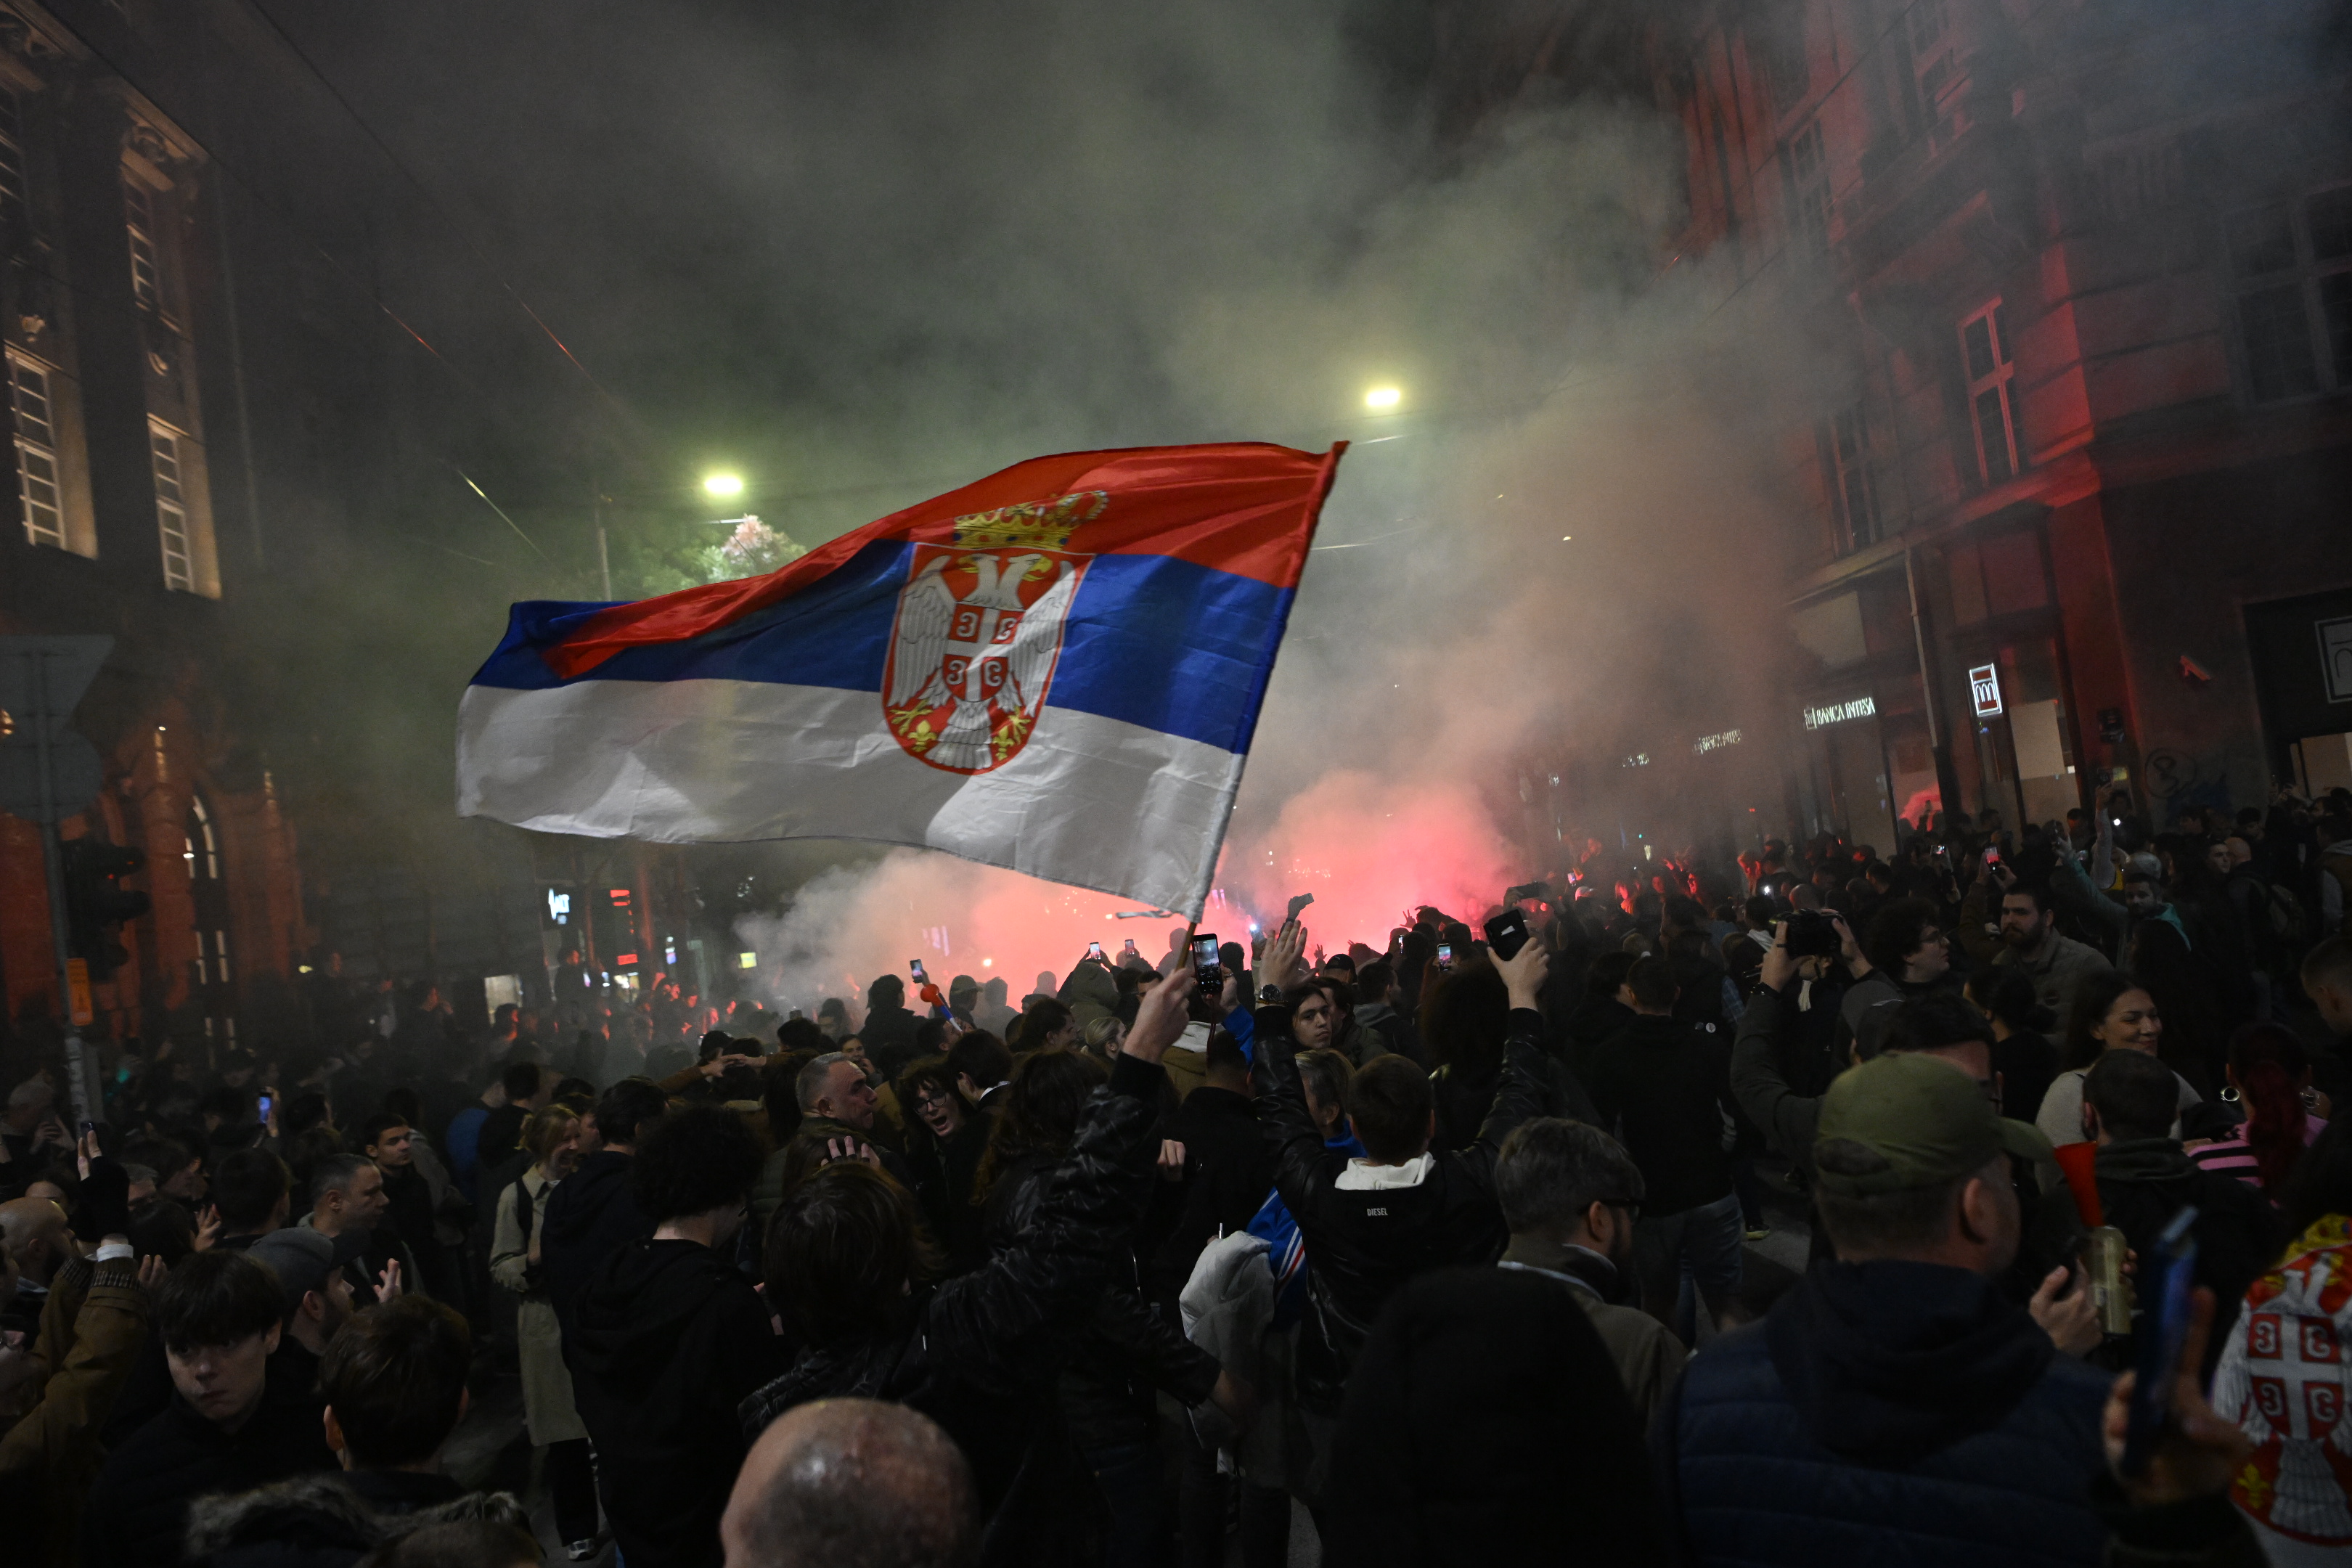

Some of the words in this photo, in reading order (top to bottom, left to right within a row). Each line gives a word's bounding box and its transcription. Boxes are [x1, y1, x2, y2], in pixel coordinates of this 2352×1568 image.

[1816, 703, 1845, 725] BANCA
[1845, 697, 1876, 719] INTESA
[1367, 1207, 1388, 1217] DIESEL
